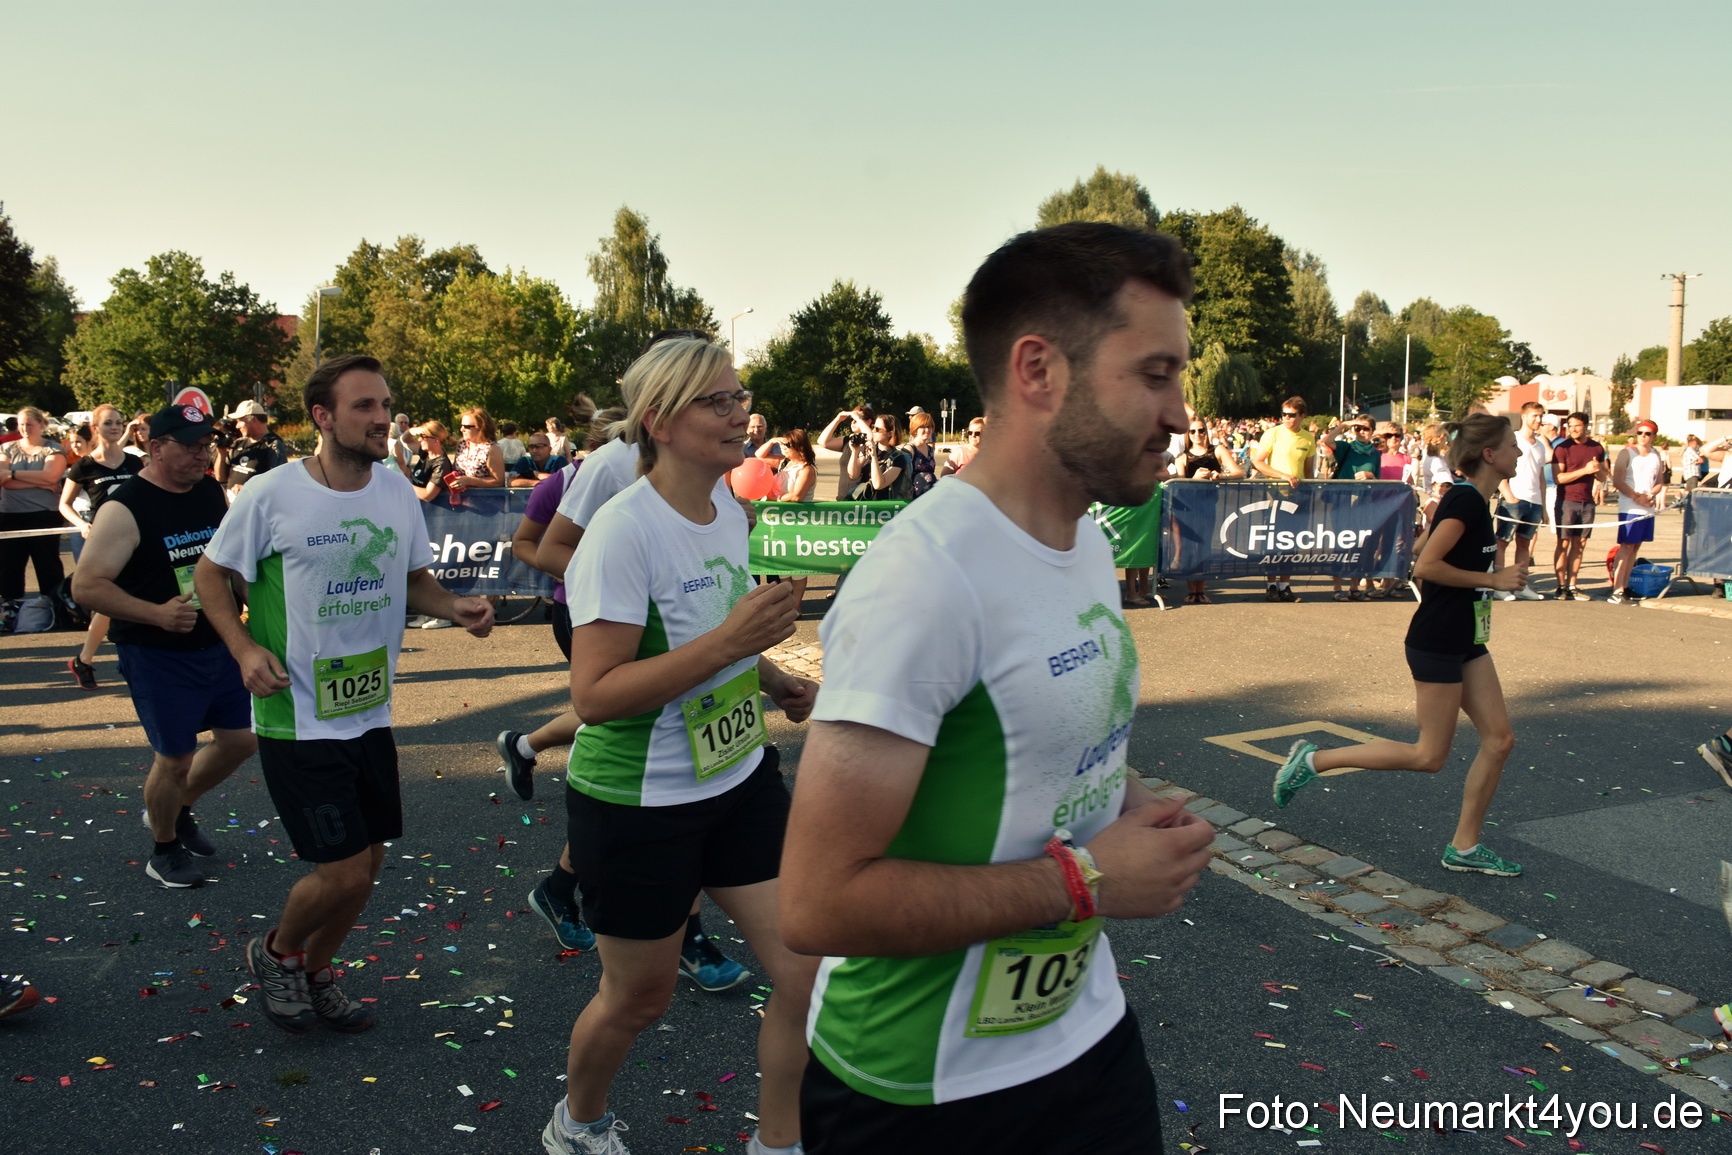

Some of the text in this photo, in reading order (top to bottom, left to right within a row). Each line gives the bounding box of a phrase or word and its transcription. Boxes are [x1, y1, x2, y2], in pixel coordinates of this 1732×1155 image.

[163, 526, 219, 549] Diakonie
[763, 535, 787, 557] in
[1248, 523, 1373, 551] Fischer
[1258, 552, 1361, 565] AUTOMOBILE
[326, 573, 386, 596] Laufend
[318, 593, 392, 618] erfolgreich
[327, 669, 382, 702] 1025
[334, 693, 377, 708] Riepl Sebastian
[701, 699, 756, 753] 1028
[302, 803, 346, 848] 10
